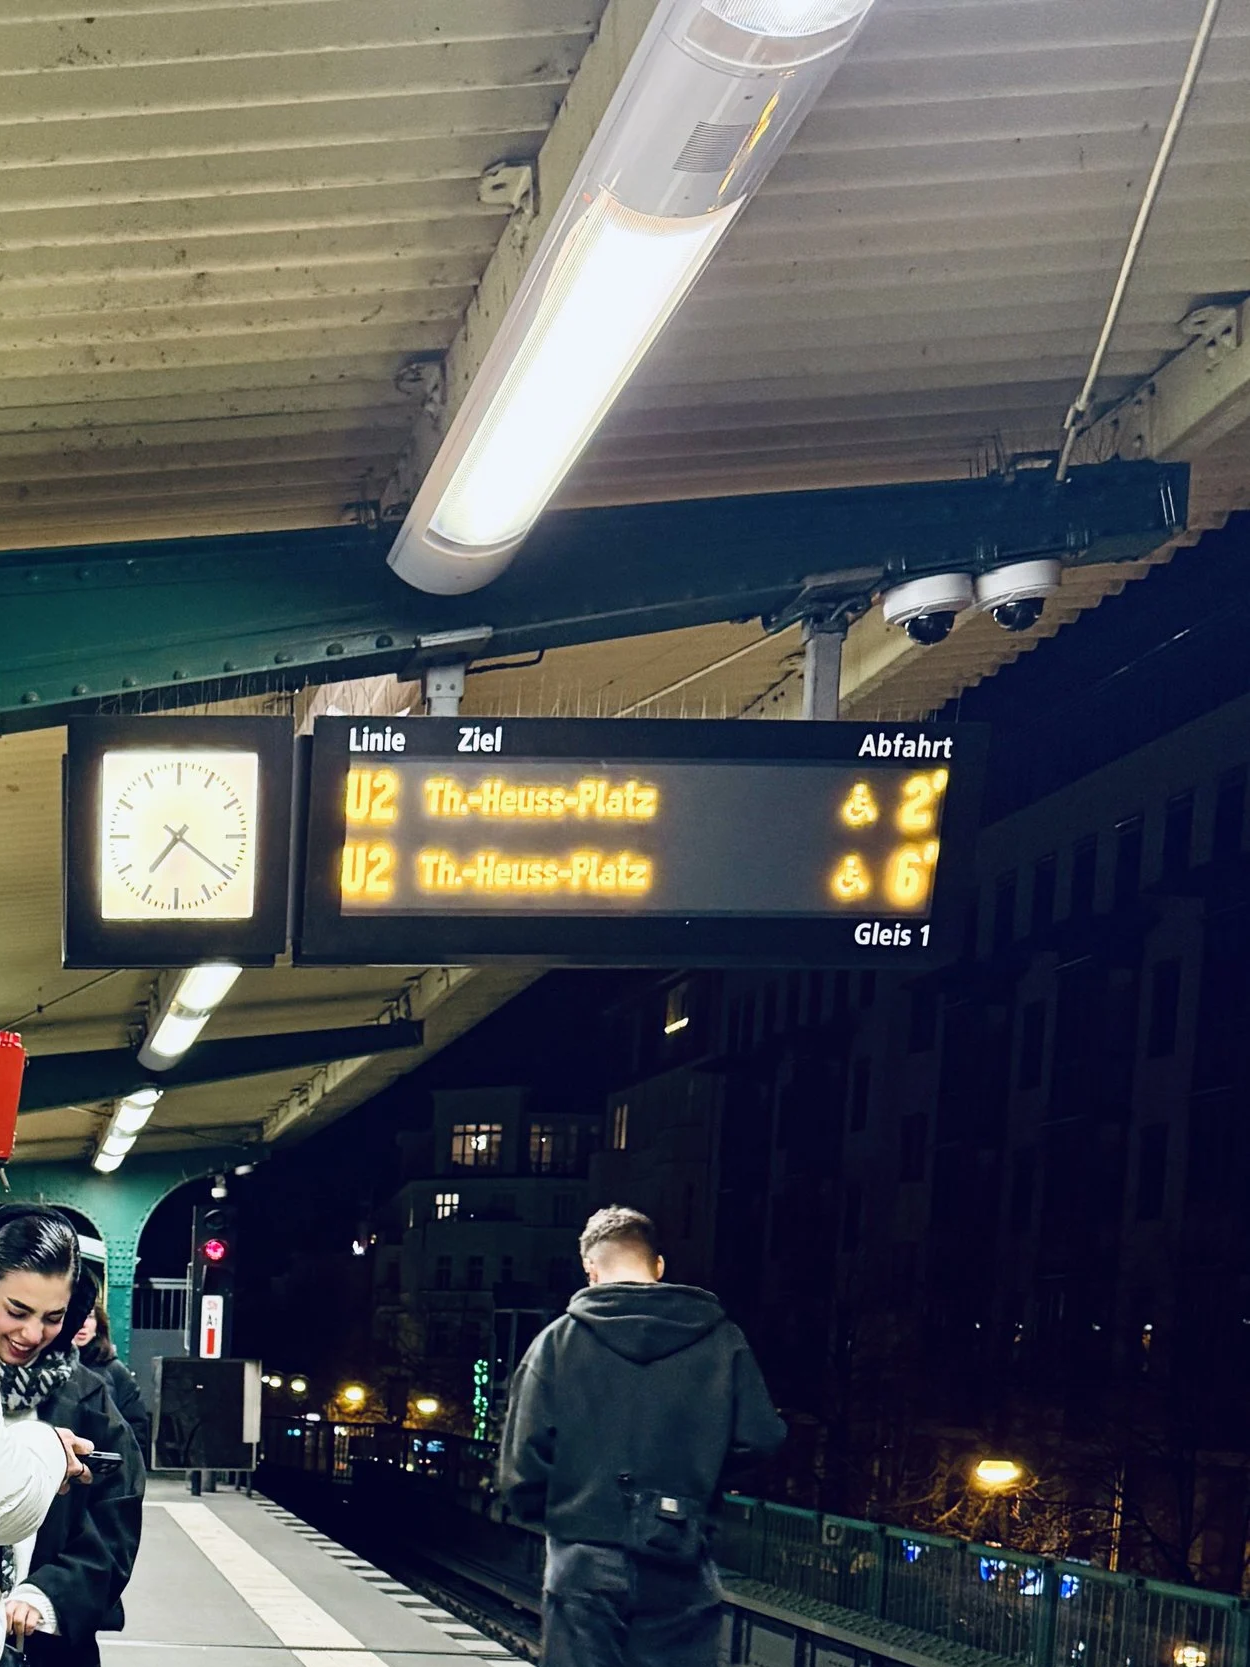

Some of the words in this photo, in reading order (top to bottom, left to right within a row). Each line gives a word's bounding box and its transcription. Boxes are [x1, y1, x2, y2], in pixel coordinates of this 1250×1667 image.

[349, 727, 406, 752] Linie
[458, 726, 503, 752] Ziel
[858, 733, 953, 759] Abfahrt
[346, 769, 398, 822] U2
[424, 778, 659, 819] Th.-Heuss-Platz
[341, 845, 393, 894] U2
[420, 852, 651, 890] Th.-Heuss-Platz
[854, 921, 912, 947] Gleis
[919, 925, 931, 947] 1
